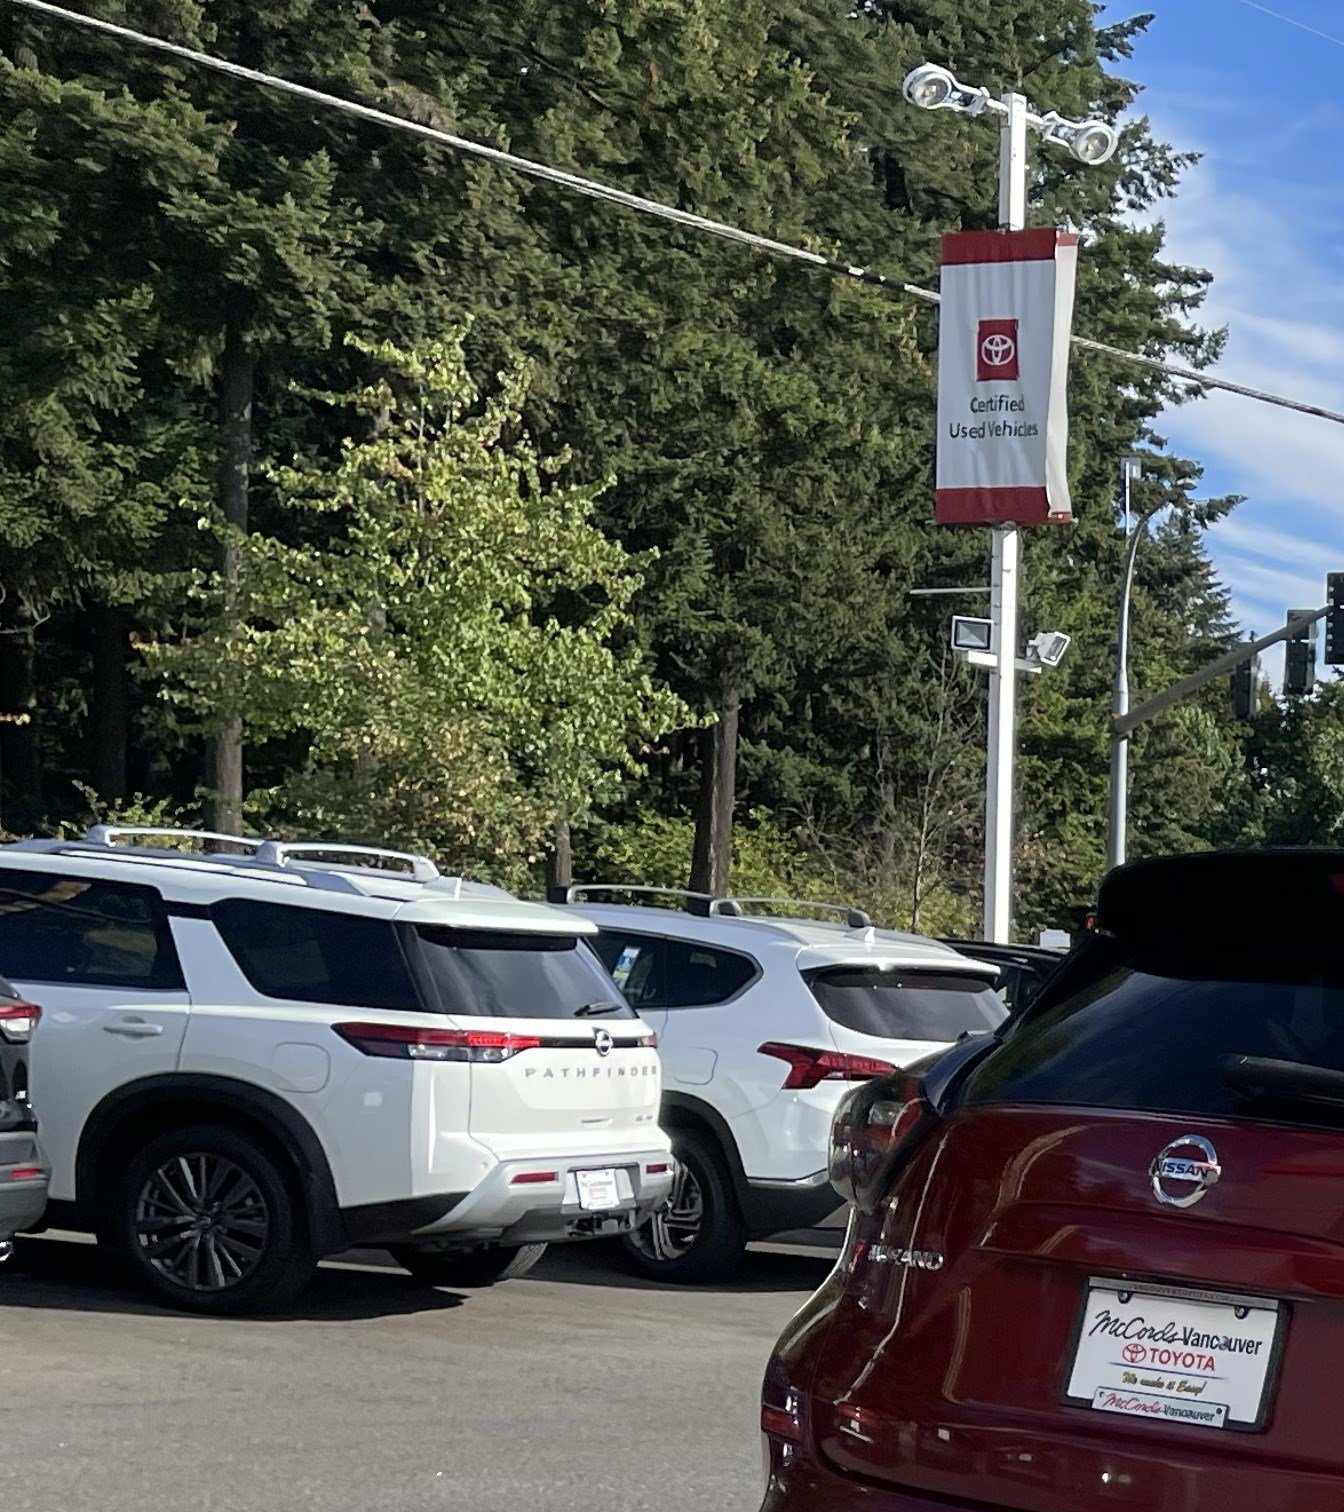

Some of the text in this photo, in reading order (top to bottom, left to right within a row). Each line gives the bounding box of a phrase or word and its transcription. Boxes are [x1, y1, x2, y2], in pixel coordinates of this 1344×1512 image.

[970, 393, 1025, 413] Certified
[949, 420, 1039, 438] Used Vehicles
[524, 1064, 658, 1079] PATHFINDER
[1149, 1346, 1216, 1371] TOYOTA
